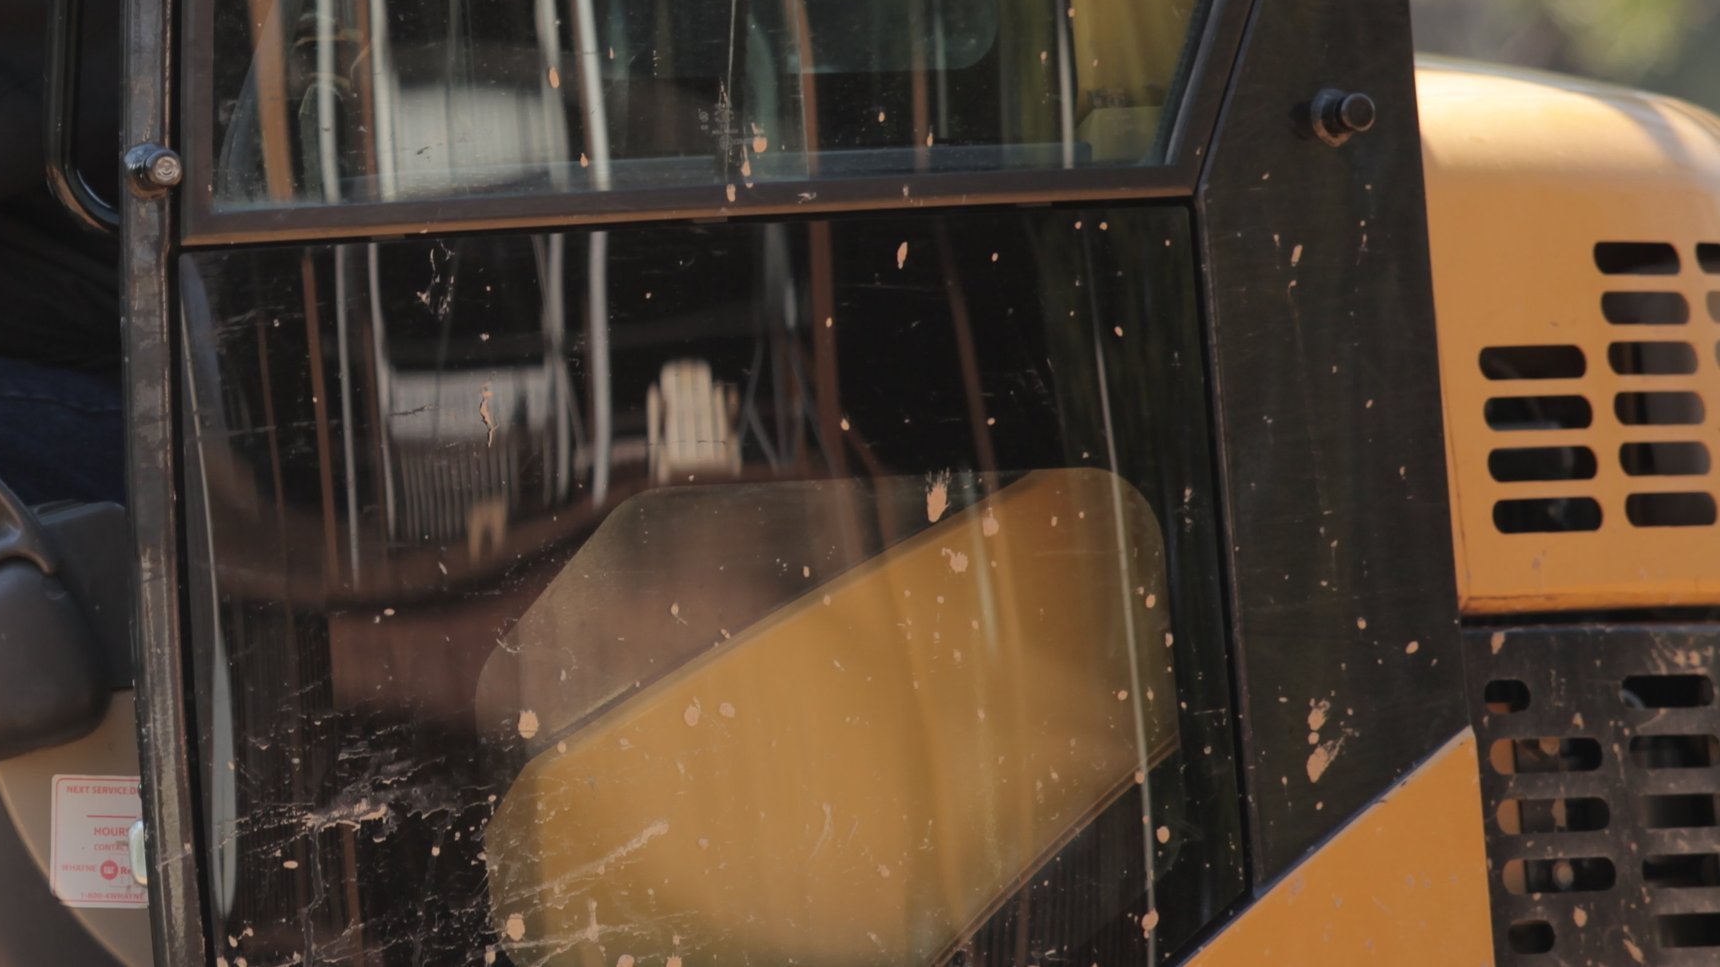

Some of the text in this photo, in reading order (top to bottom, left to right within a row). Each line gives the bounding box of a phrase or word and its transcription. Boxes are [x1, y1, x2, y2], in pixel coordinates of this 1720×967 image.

[66, 785, 90, 794] NEXT
[92, 785, 127, 795] SERVICE
[93, 843, 129, 852] CONTAC
[61, 863, 97, 873] WHAYNE
